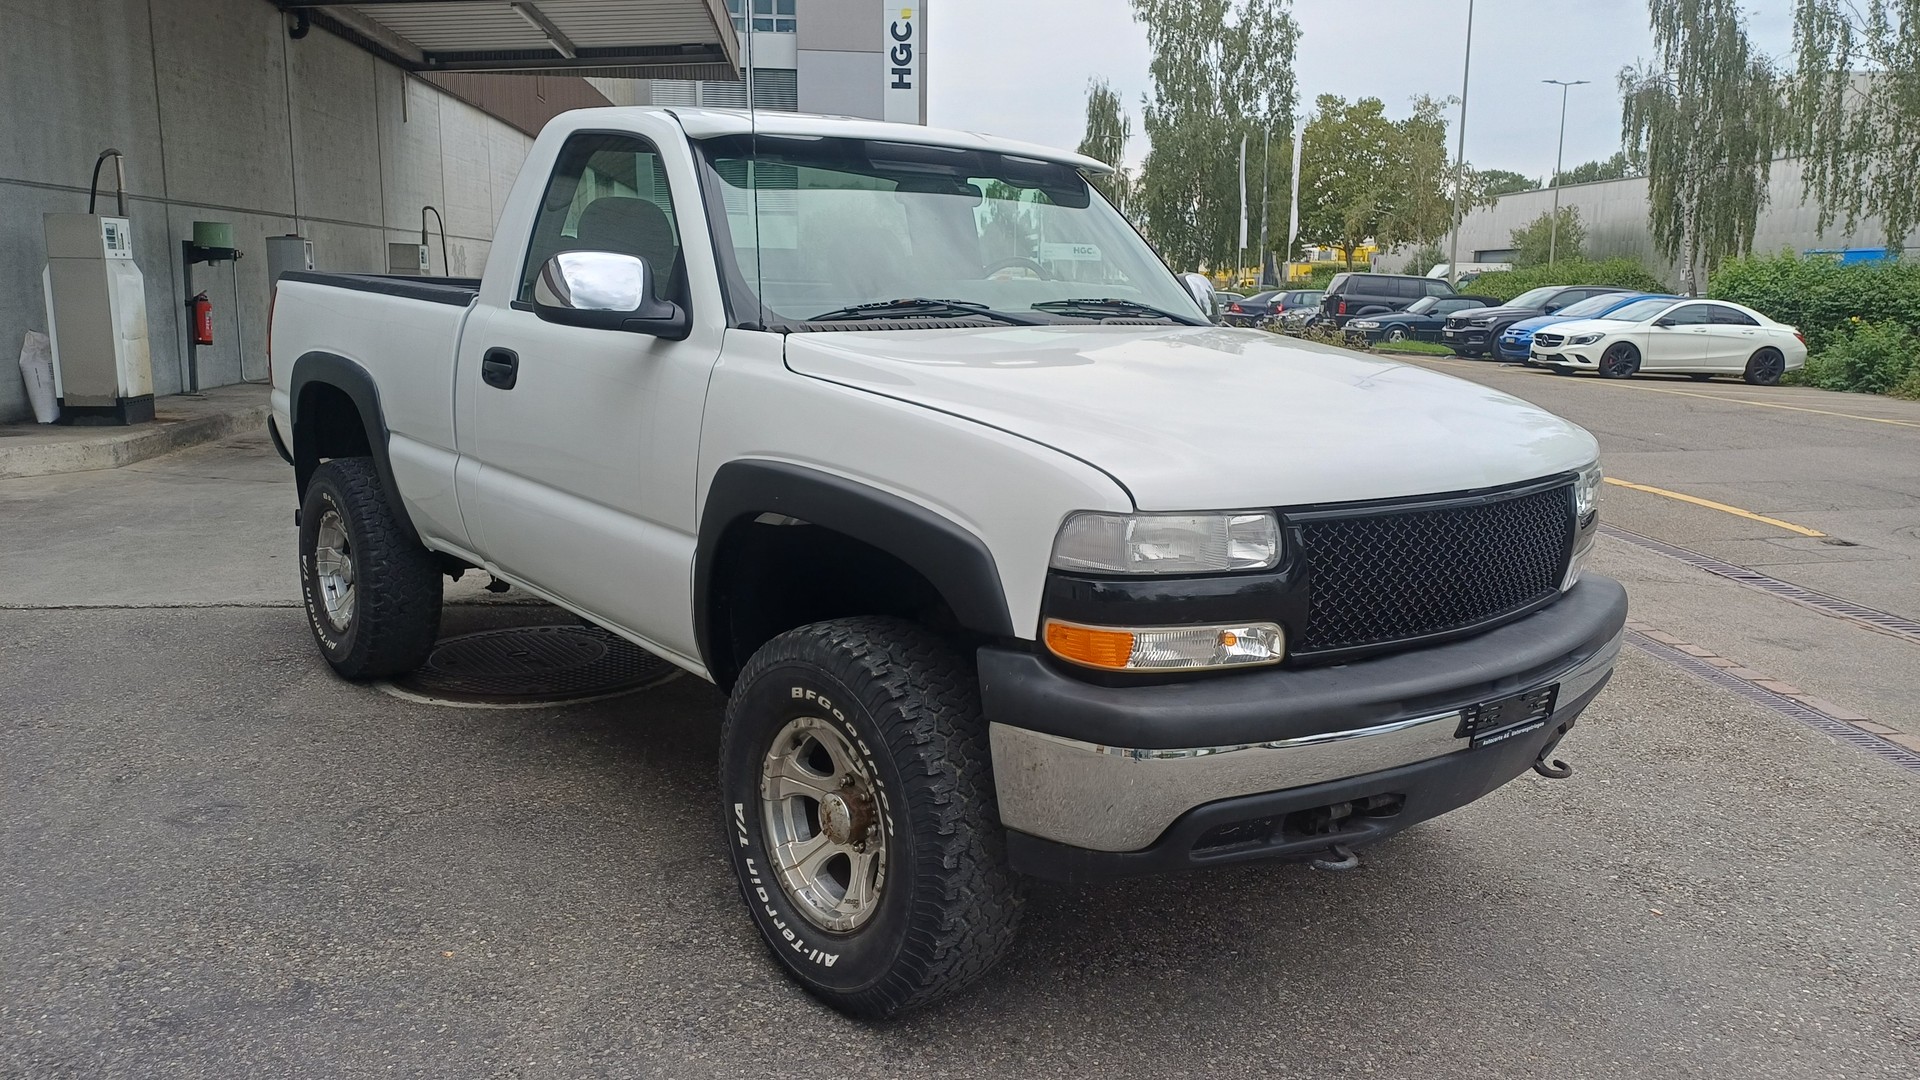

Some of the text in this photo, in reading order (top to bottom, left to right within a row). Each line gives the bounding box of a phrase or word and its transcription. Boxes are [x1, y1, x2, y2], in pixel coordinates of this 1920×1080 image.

[890, 21, 912, 89] HGC
[1073, 246, 1093, 255] HGC
[791, 687, 895, 837] BFGoodrich
[734, 803, 840, 968] All-Terrain T/A
